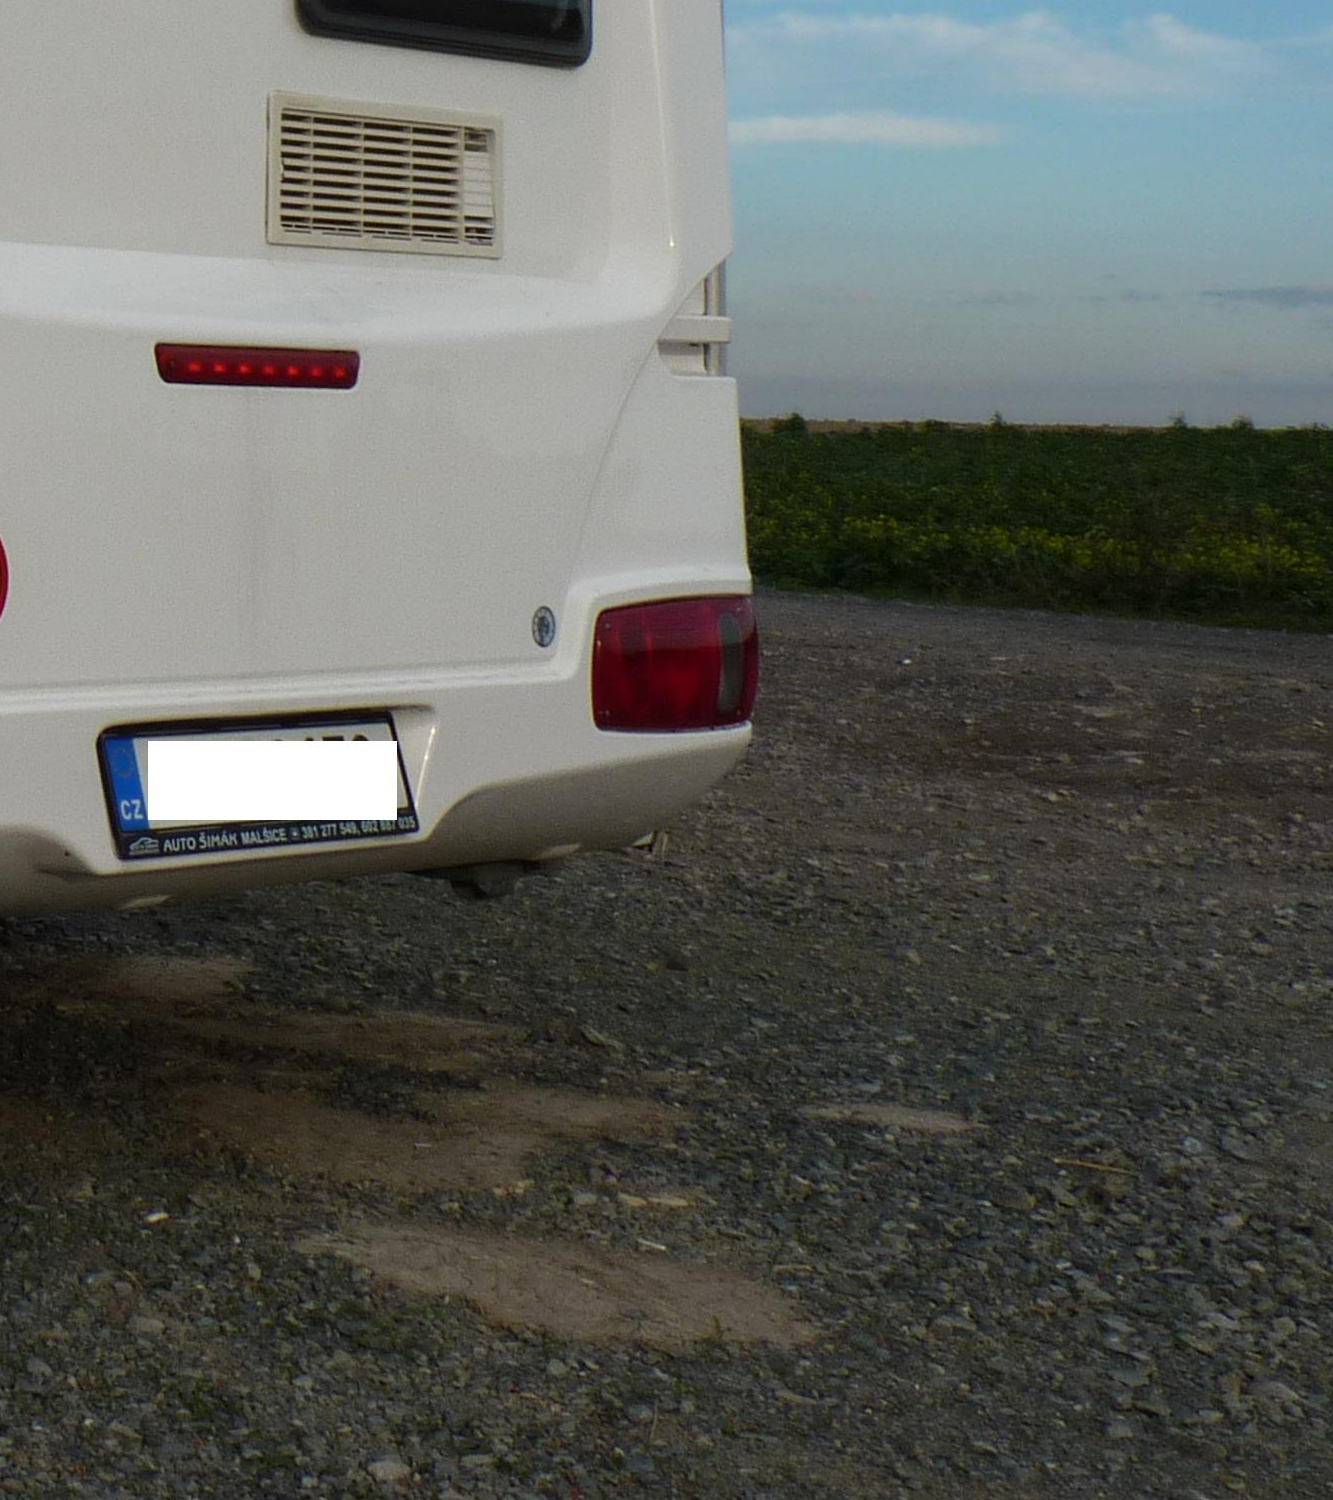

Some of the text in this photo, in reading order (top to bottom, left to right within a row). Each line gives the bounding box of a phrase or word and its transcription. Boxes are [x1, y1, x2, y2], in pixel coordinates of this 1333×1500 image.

[121, 799, 143, 820] CZ
[163, 836, 196, 852] AUTO
[198, 831, 238, 849] ŠIMÁK
